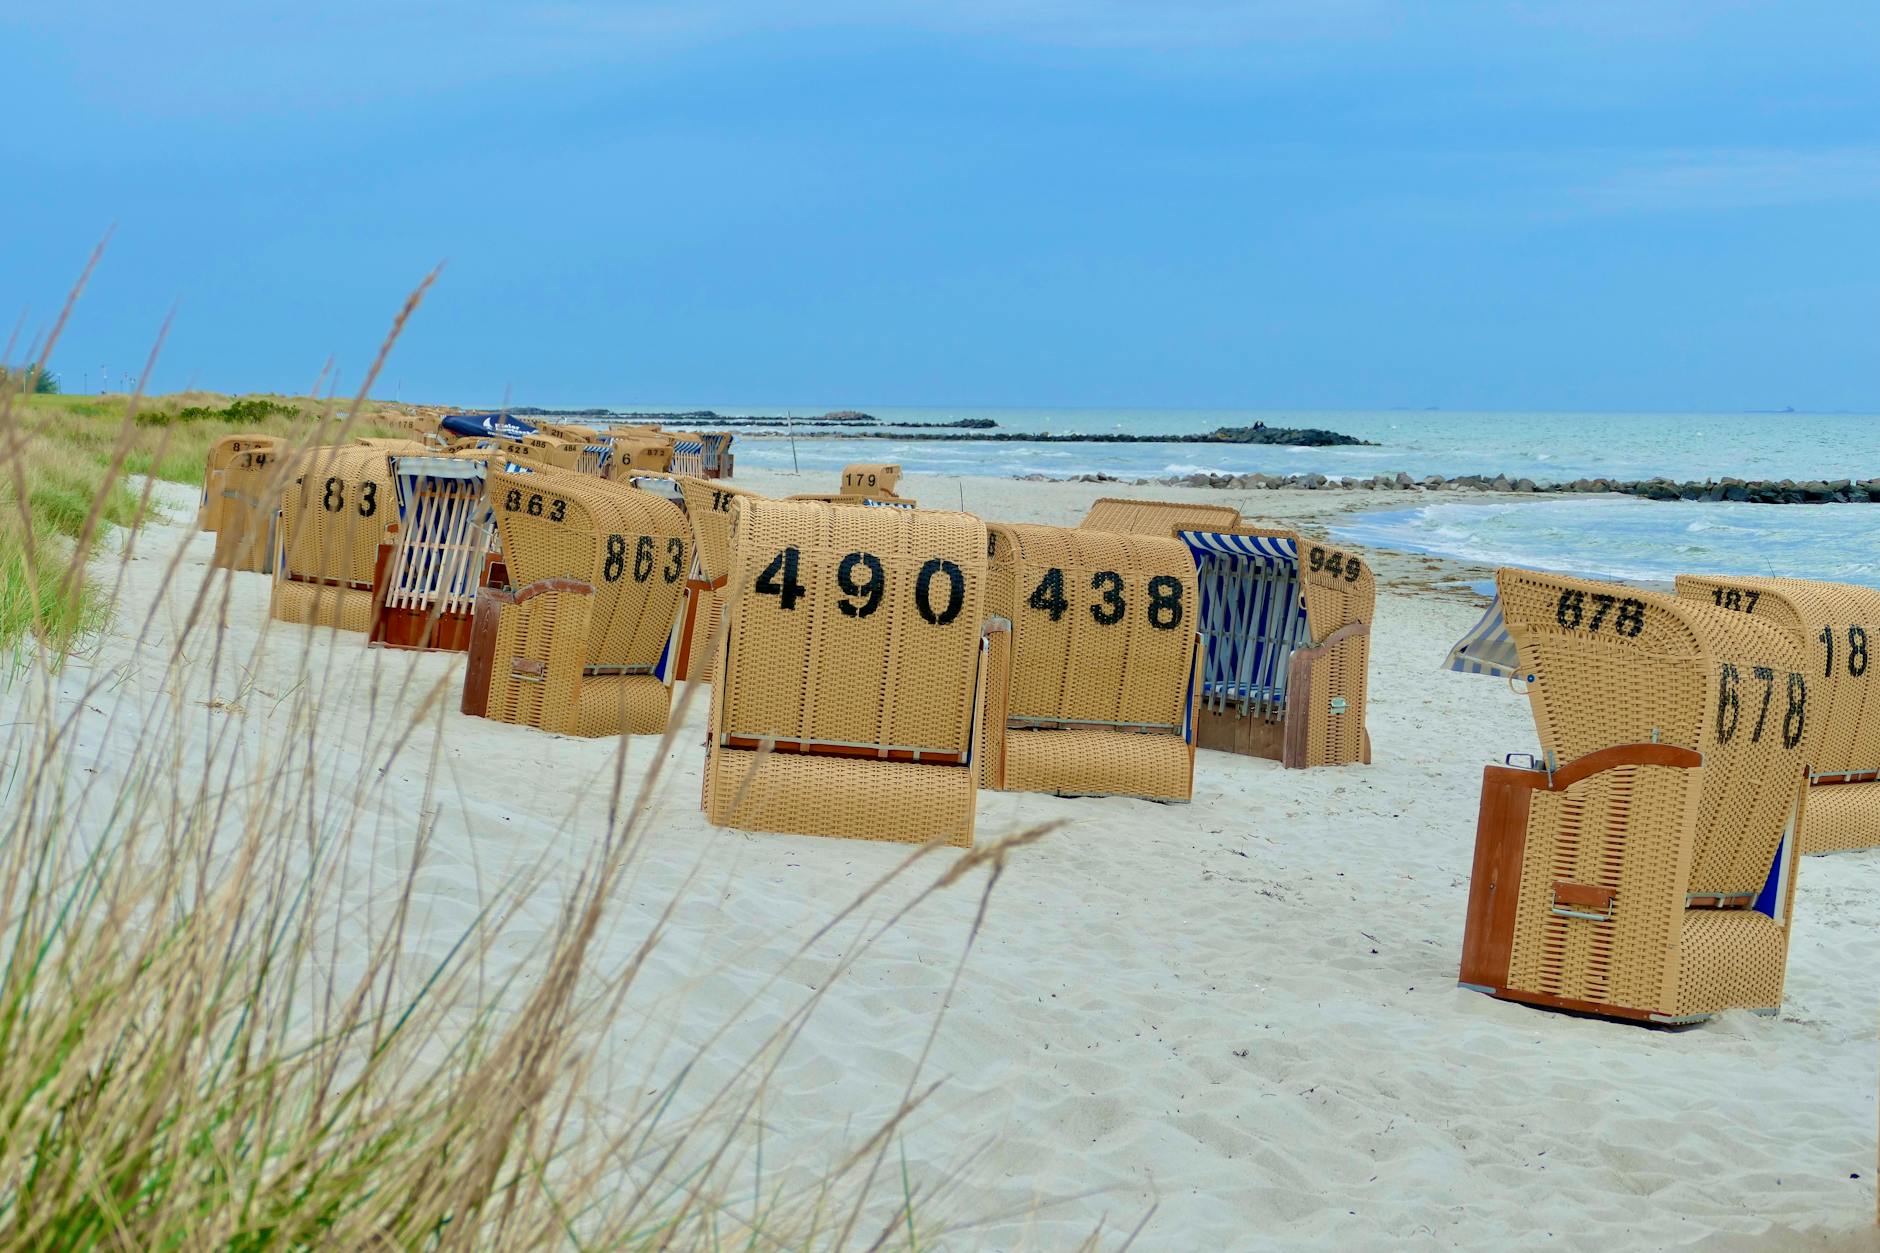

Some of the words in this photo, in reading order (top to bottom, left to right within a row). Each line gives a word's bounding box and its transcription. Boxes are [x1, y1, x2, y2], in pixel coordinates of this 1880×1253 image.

[622, 453, 631, 465] 6
[845, 474, 876, 487] 179
[505, 488, 567, 522] 863
[603, 534, 685, 584] 863
[1309, 547, 1361, 582] 949
[755, 544, 966, 626] 490
[1028, 567, 1184, 630] 438
[1712, 588, 1761, 615] 187
[1556, 588, 1646, 637] 678
[1819, 623, 1869, 678] 18
[1716, 662, 1808, 750] 678
